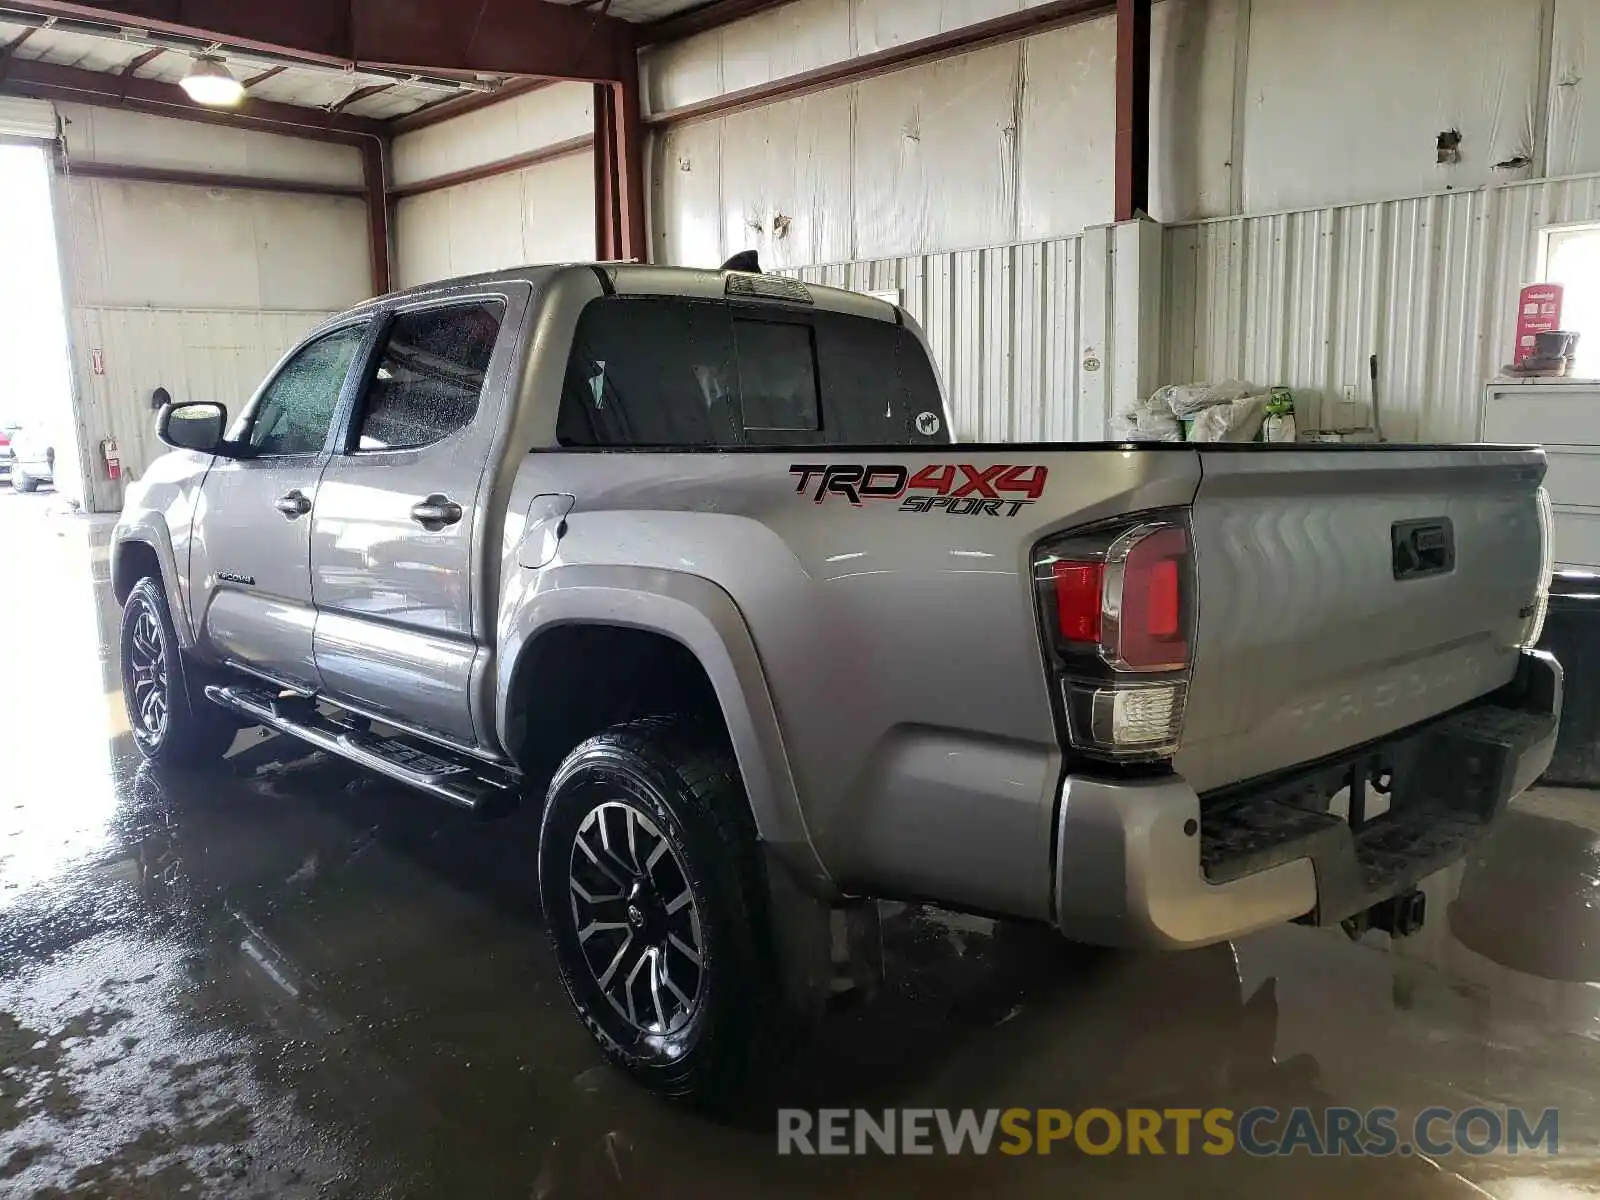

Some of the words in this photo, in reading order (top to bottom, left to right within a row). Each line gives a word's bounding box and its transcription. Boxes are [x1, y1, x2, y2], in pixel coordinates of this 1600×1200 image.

[788, 464, 910, 507] TRD
[908, 464, 1049, 499] 4X4
[899, 495, 1037, 518] SPORT
